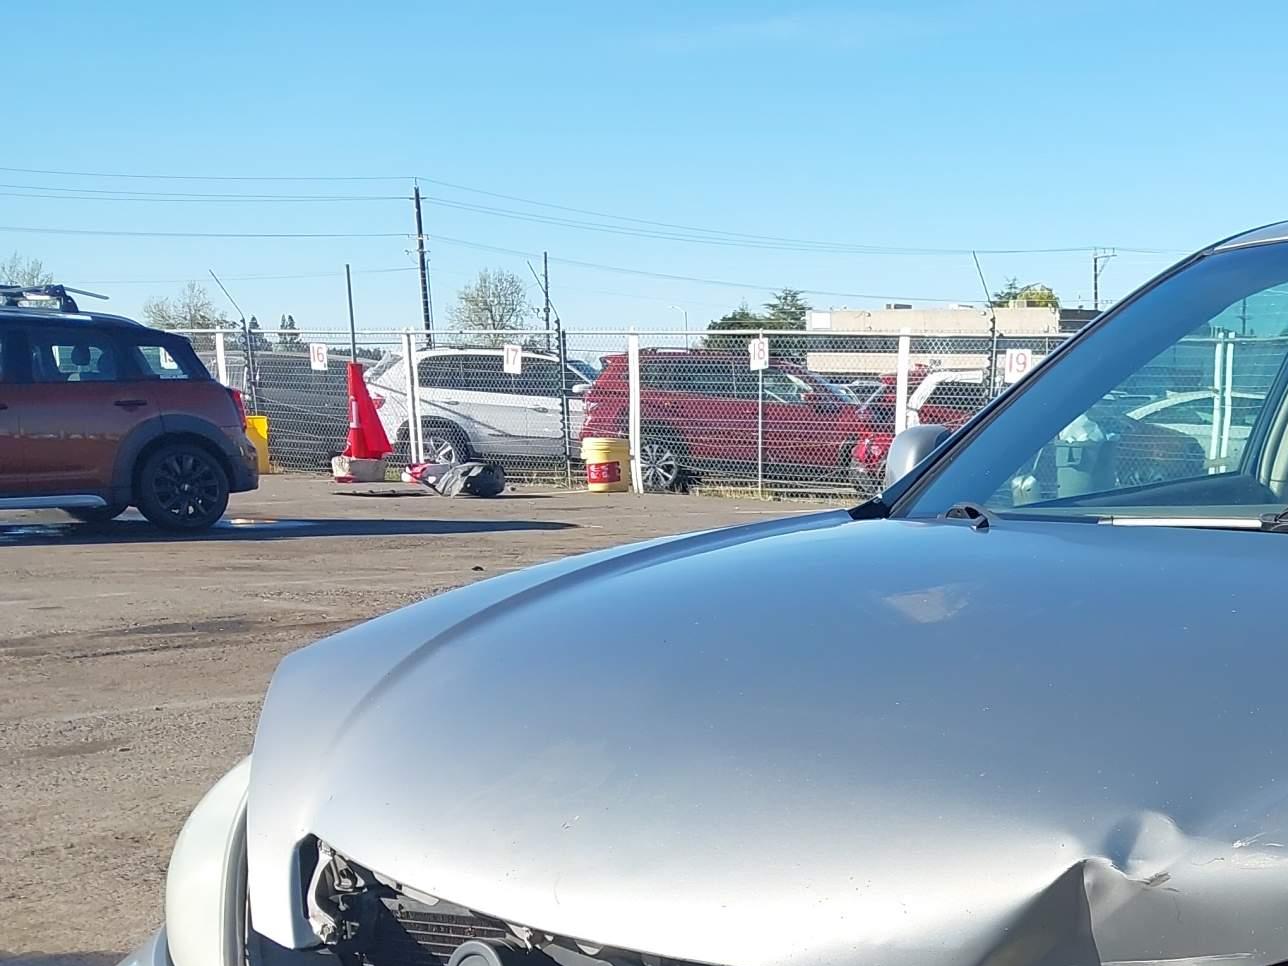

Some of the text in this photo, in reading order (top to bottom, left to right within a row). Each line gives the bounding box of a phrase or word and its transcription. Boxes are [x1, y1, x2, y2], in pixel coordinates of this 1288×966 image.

[311, 345, 325, 363] 16
[506, 347, 519, 365] 17
[753, 341, 766, 360] 18
[1008, 352, 1027, 373] 19
